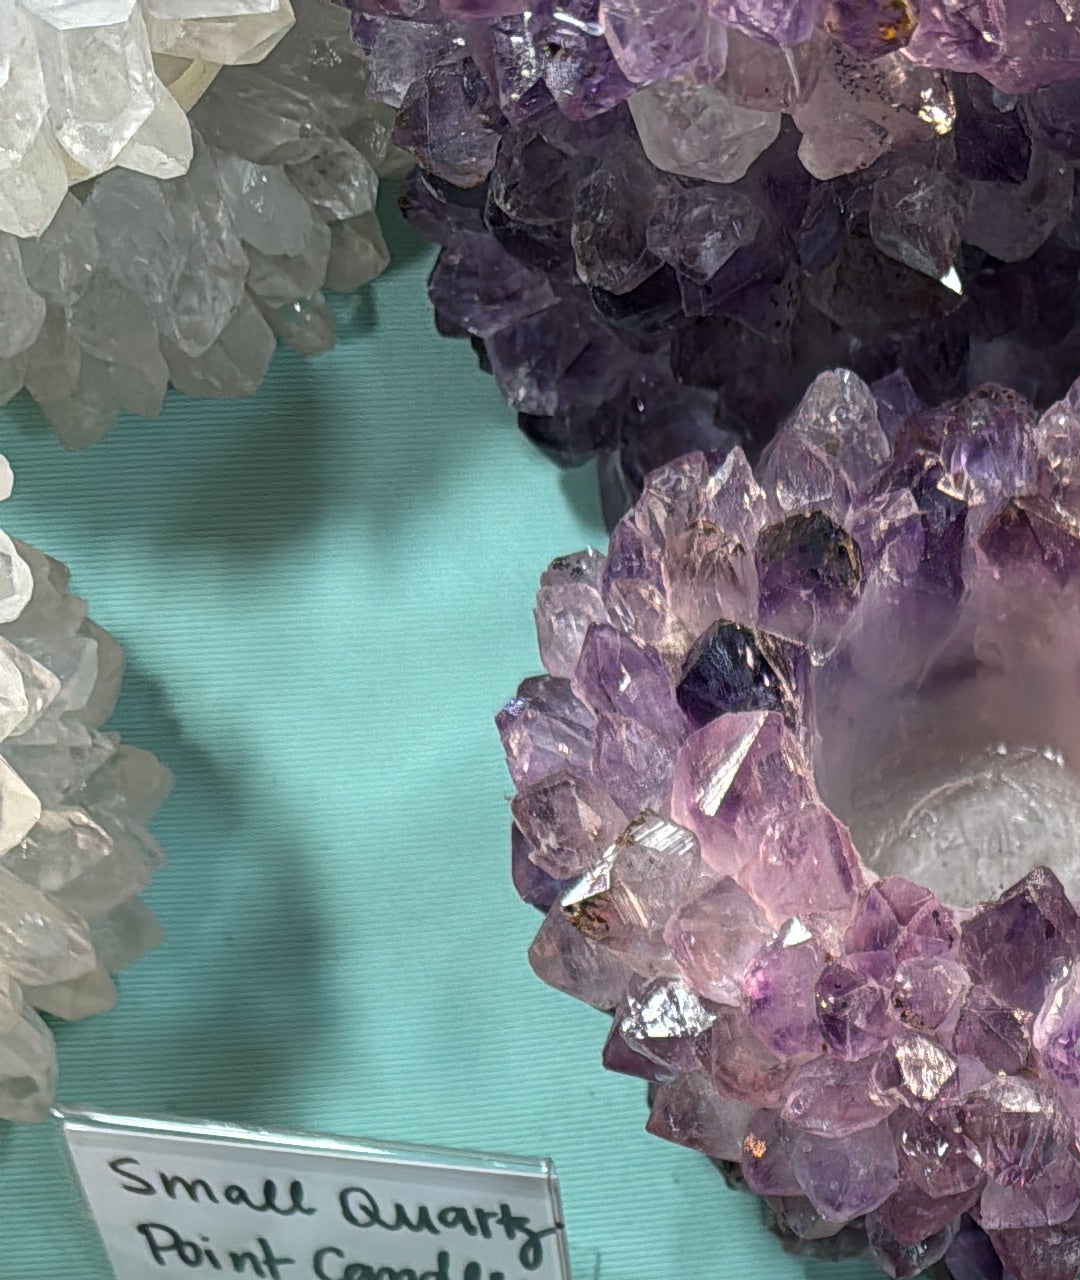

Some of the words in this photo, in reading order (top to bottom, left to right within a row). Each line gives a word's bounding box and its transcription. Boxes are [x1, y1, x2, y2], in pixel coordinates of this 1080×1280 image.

[108, 1157, 317, 1215] Small
[339, 1186, 564, 1270] Quartz
[137, 1221, 294, 1280] Point
